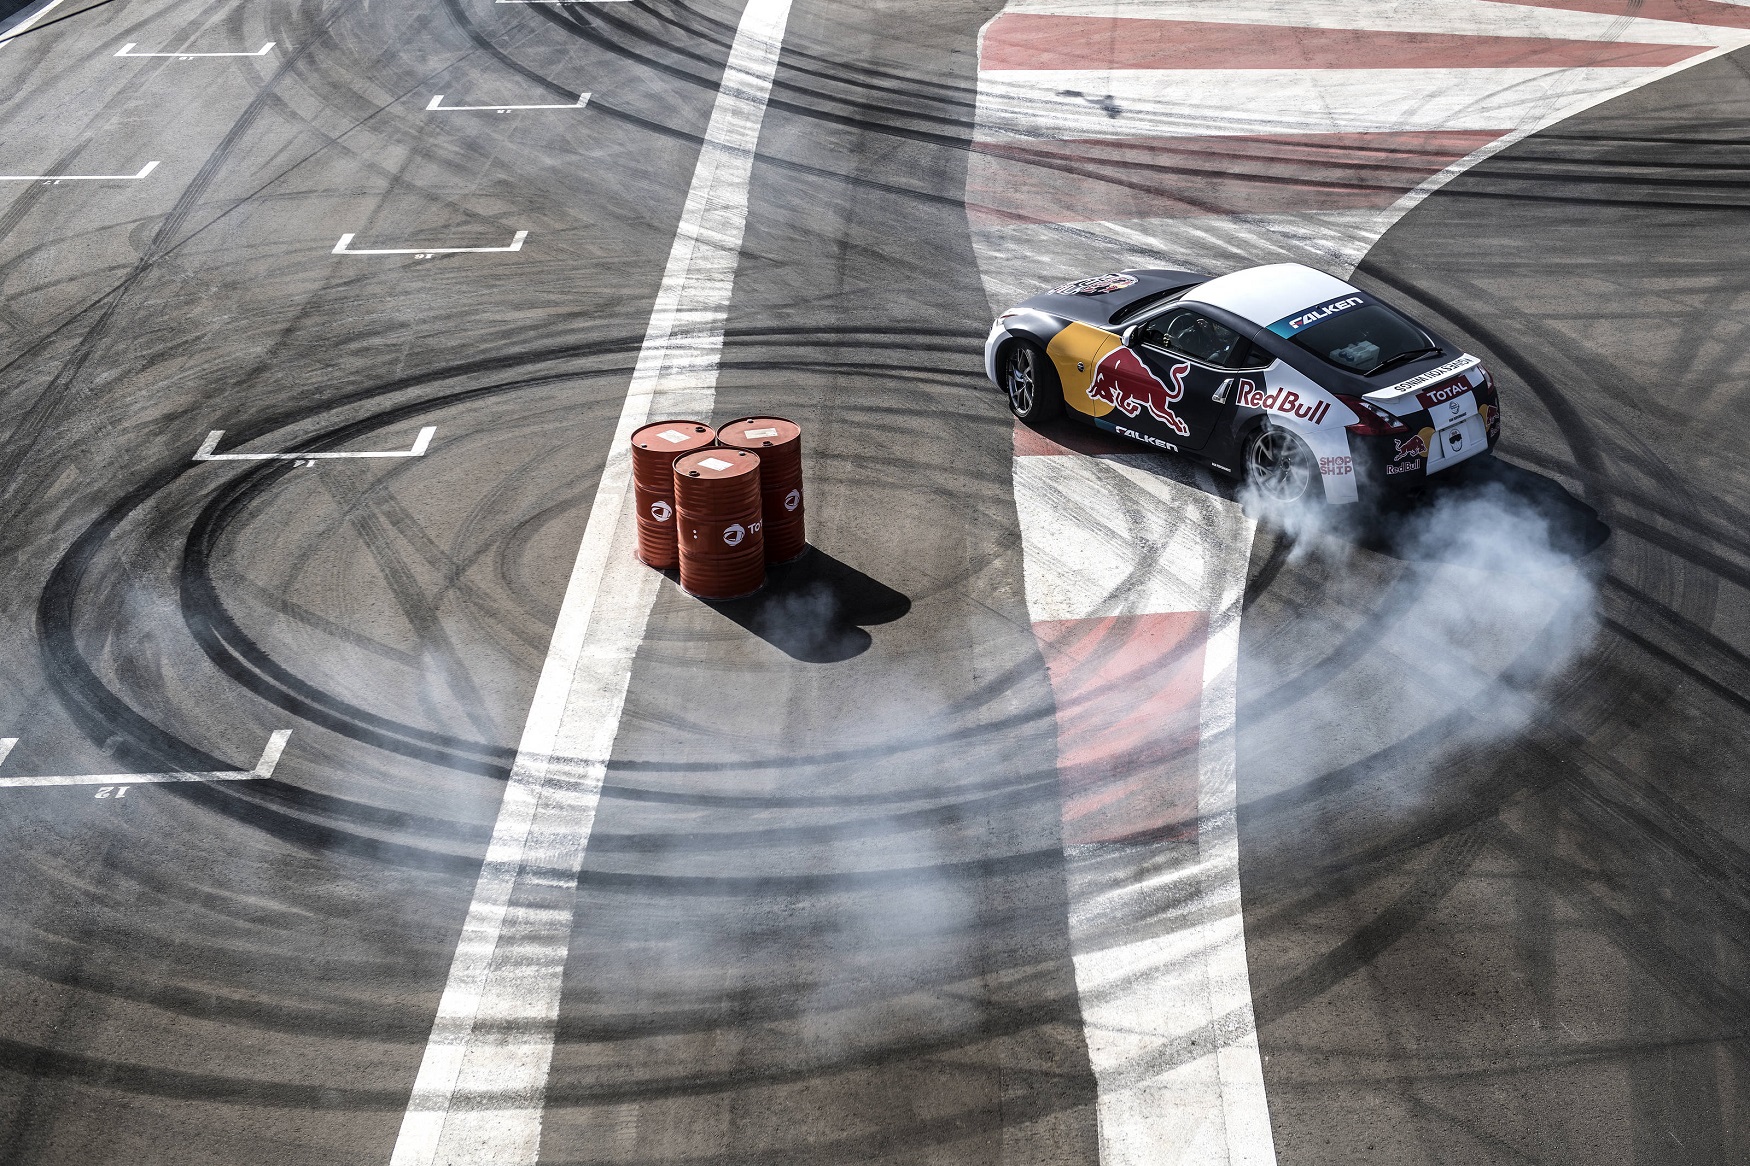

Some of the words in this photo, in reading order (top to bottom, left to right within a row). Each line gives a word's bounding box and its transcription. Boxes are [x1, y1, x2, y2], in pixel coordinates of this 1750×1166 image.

[1289, 297, 1364, 329] FALKEN
[1236, 378, 1284, 410] Red
[1277, 391, 1331, 425] Bull
[1426, 382, 1468, 403] TOTAL
[1115, 426, 1179, 453] FALKEN
[293, 459, 317, 468] 14
[1320, 466, 1352, 475] SHIP
[1386, 462, 1404, 475] Red
[1404, 459, 1420, 472] Bull
[94, 786, 130, 800] 12
